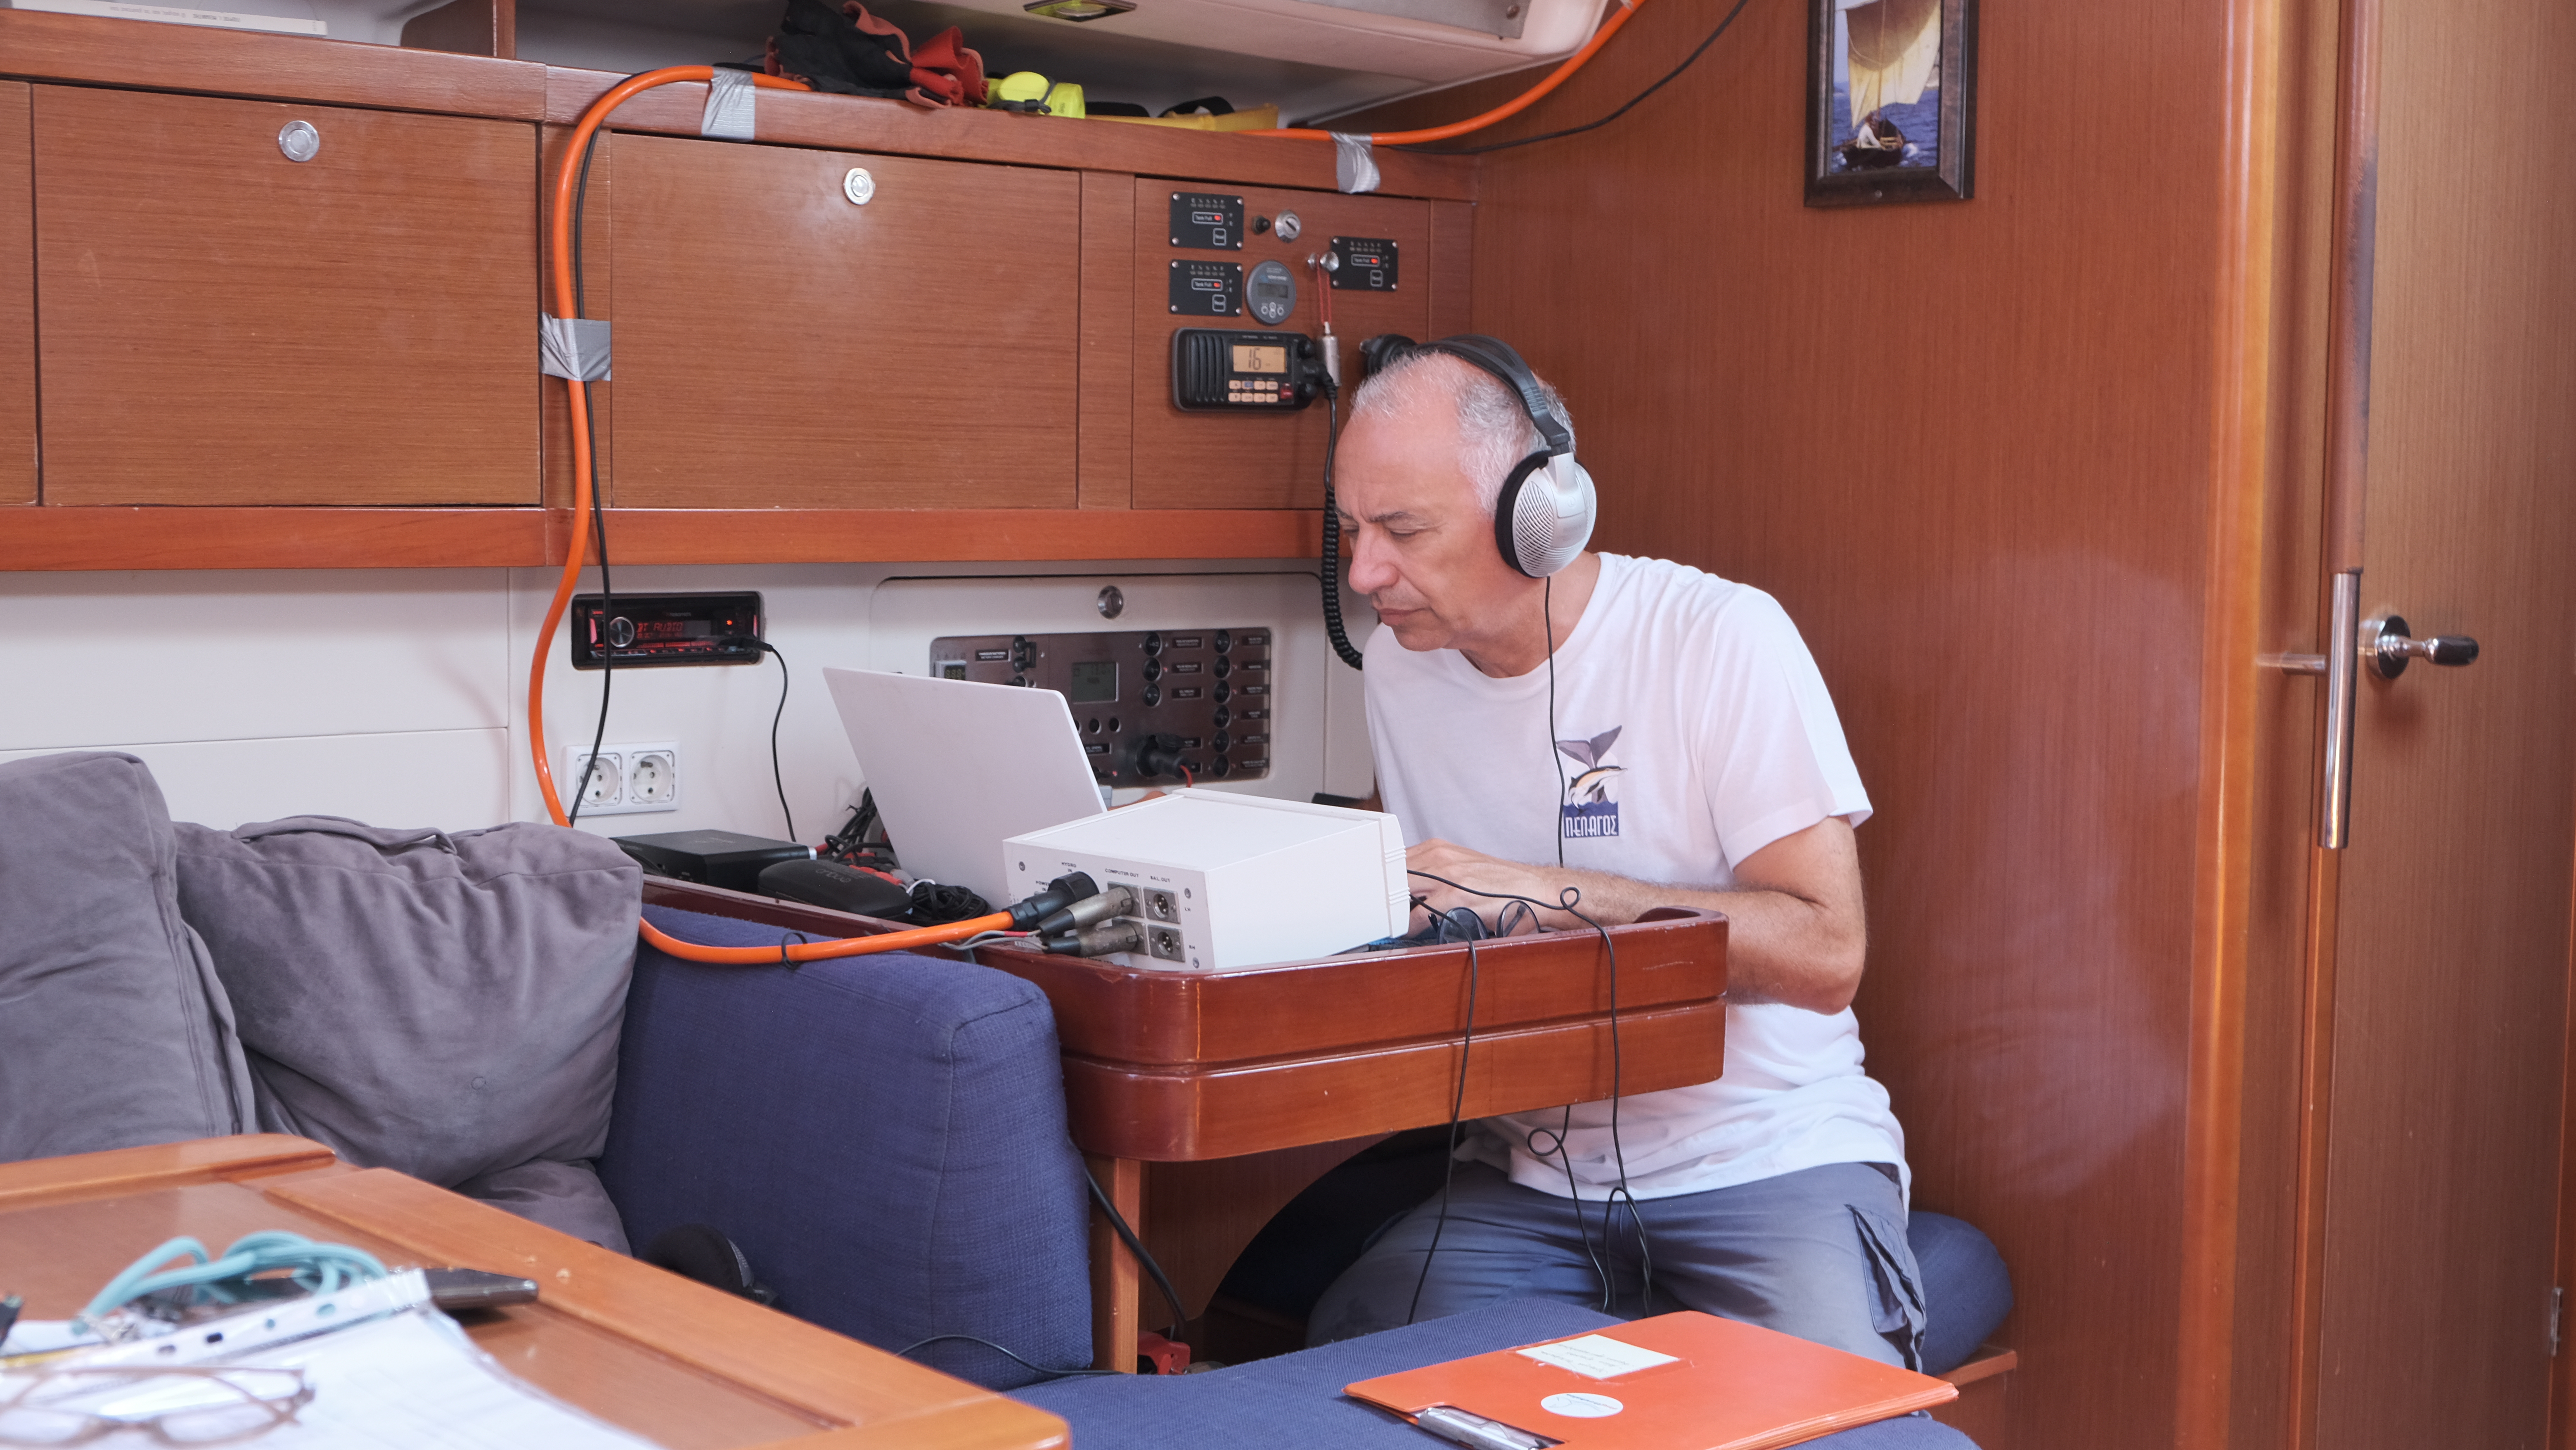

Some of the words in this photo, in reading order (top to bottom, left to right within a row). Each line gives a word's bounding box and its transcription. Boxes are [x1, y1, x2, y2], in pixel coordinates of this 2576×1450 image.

[1248, 346, 1261, 370] 16
[653, 621, 684, 632] AUDIO
[1105, 868, 1129, 876] COMPUTER
